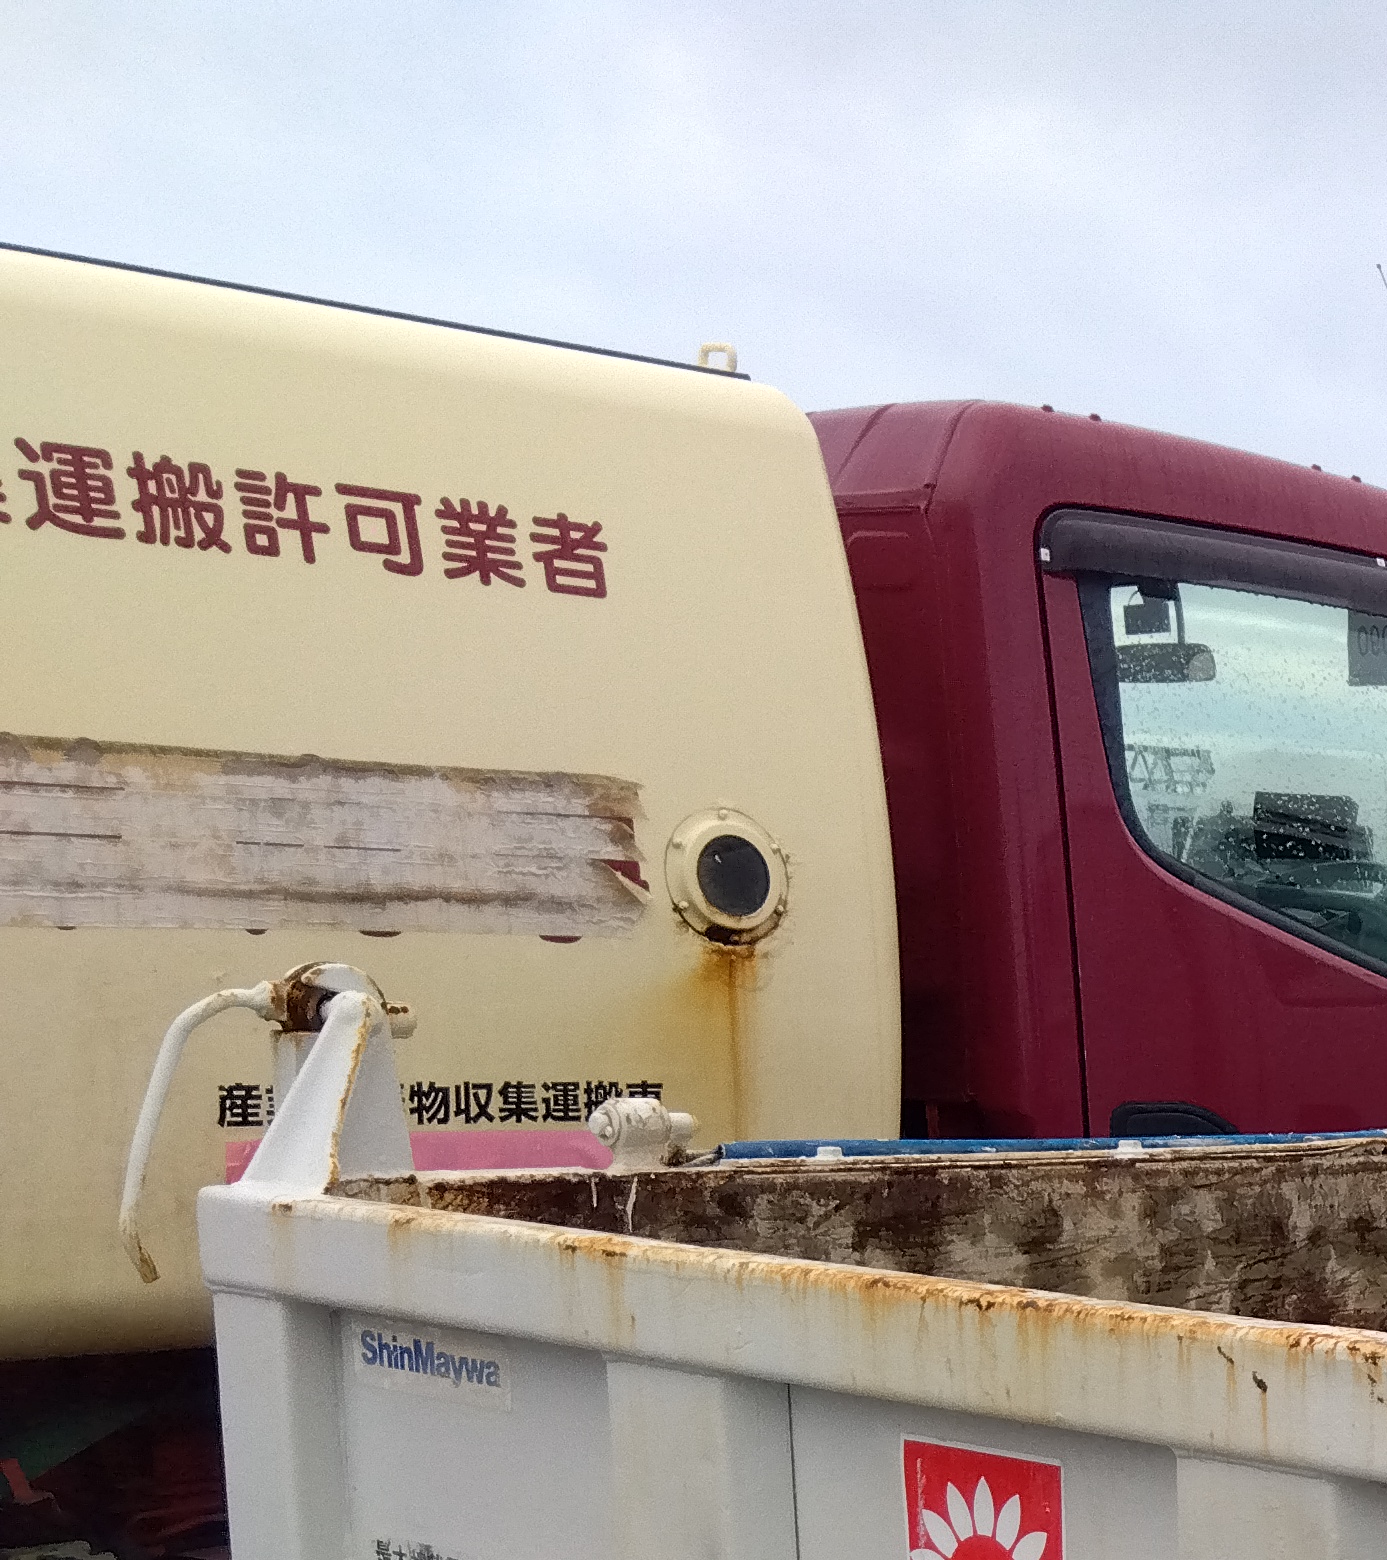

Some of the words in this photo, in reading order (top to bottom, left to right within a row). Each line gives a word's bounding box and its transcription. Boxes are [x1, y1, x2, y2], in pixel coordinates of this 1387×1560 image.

[0, 437, 609, 599] 運搬許可業者
[360, 1329, 502, 1388] ShinMaywa
